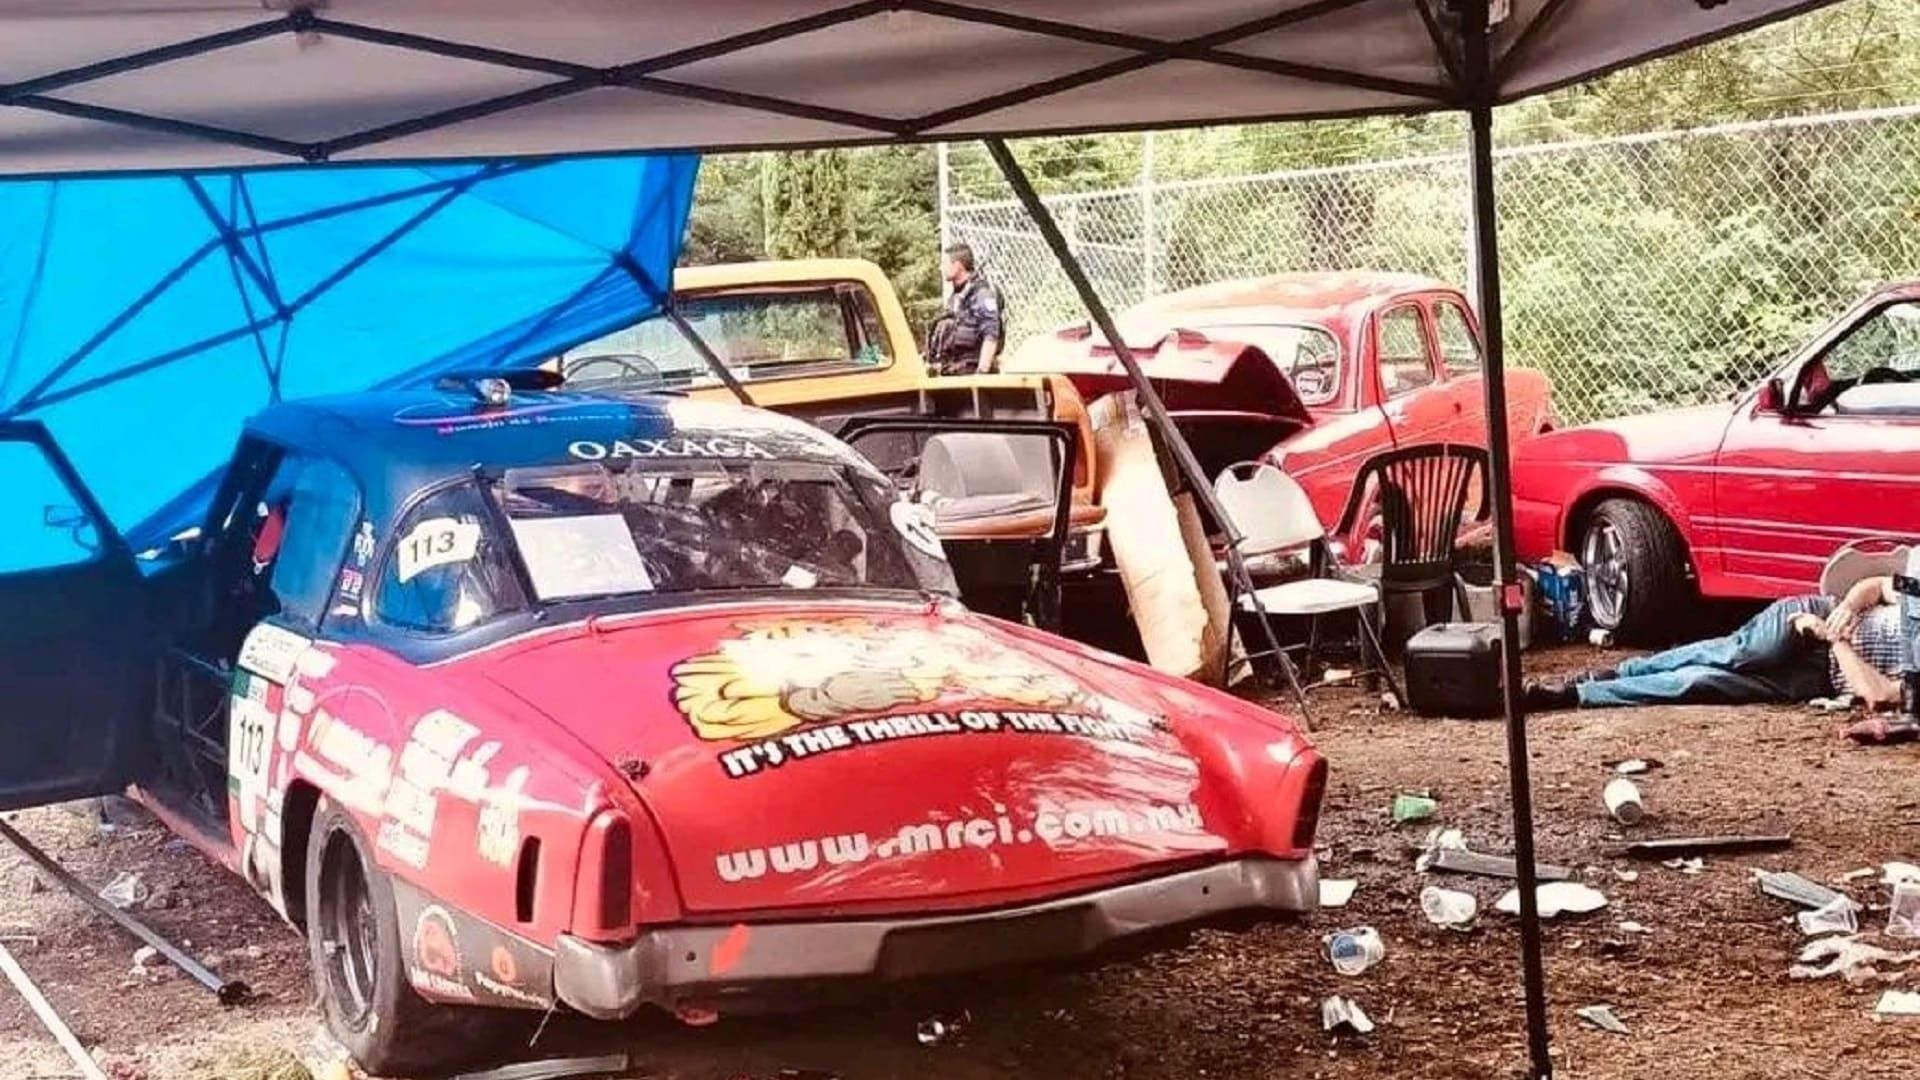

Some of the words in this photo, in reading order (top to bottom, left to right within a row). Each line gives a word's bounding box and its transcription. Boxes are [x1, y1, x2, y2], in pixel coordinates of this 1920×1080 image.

[408, 531, 455, 562] 113
[240, 715, 264, 776] 113
[721, 740, 783, 776] IT'S
[783, 725, 850, 757] THE
[848, 712, 959, 742] THRILL
[960, 711, 1001, 730] OF
[1001, 712, 1061, 731] THE
